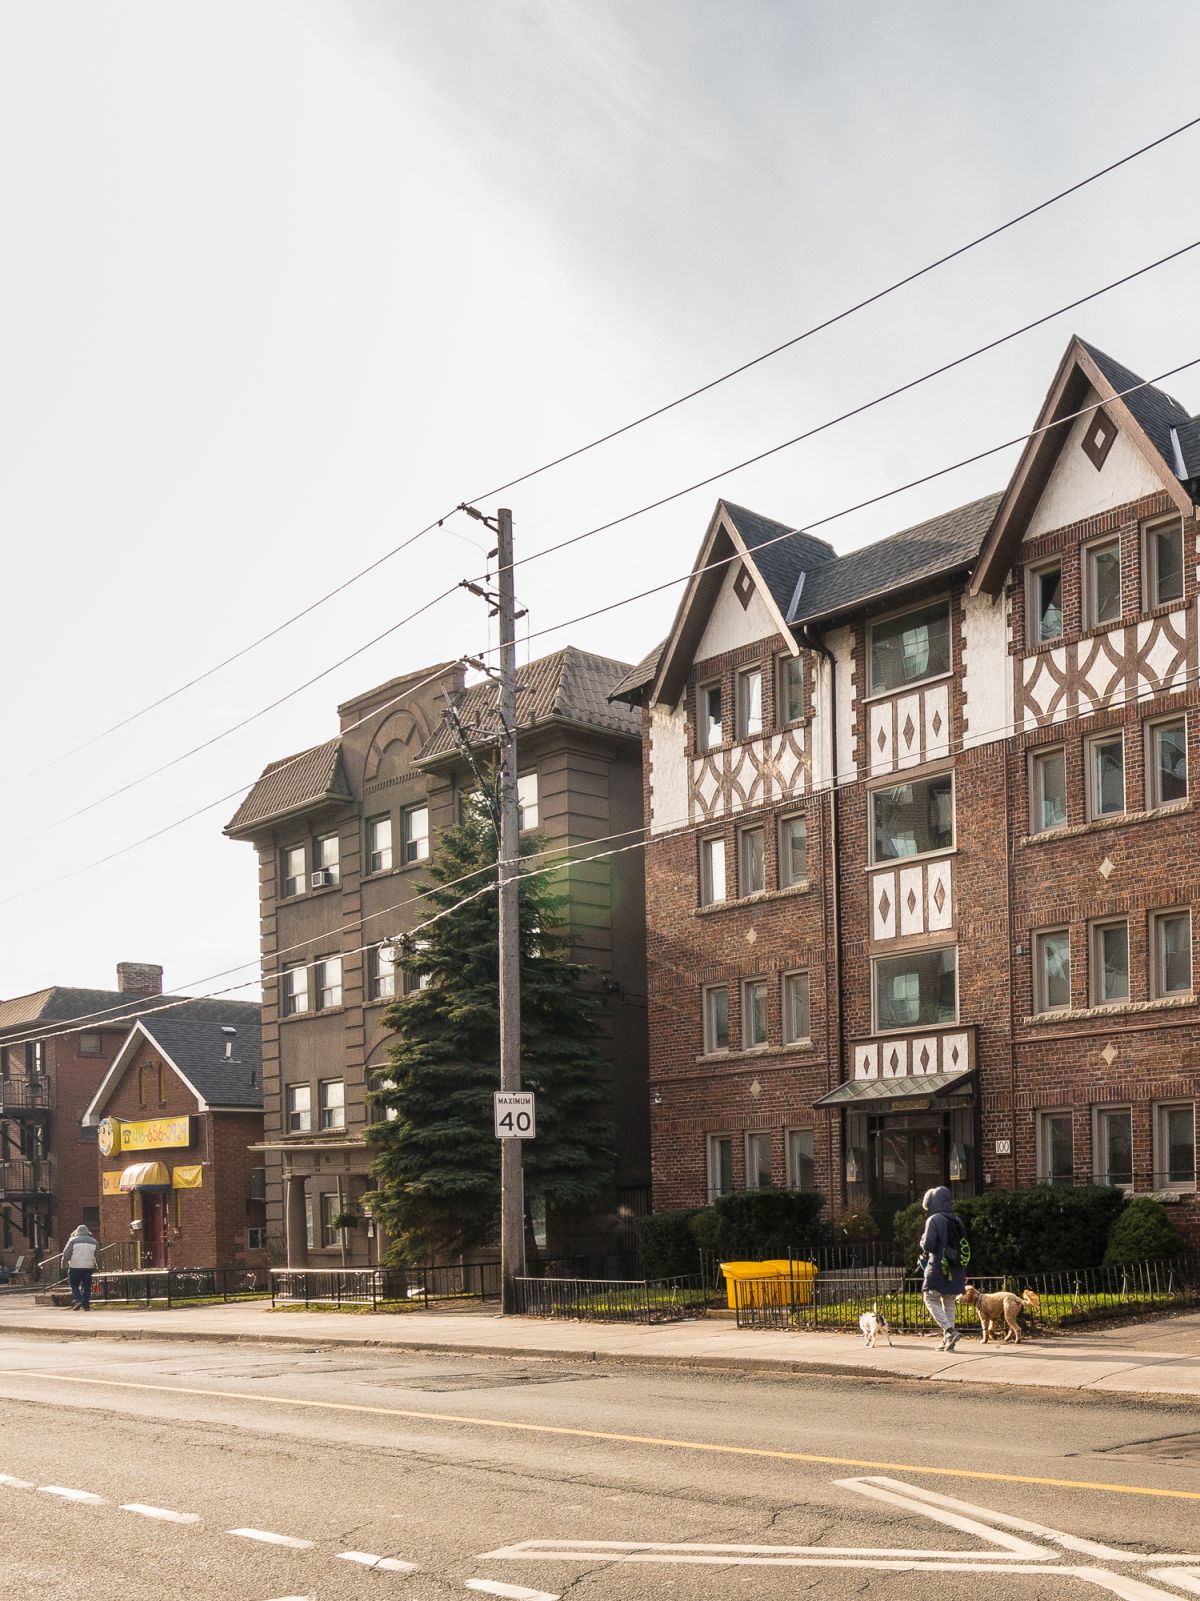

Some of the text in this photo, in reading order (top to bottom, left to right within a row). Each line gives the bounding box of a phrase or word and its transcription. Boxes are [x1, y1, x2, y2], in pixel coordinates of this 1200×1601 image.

[498, 1097, 531, 1105] MAXIMUM
[499, 1111, 531, 1131] 40
[132, 1121, 187, 1143] 416-656-2929
[996, 1141, 1009, 1152] 100
